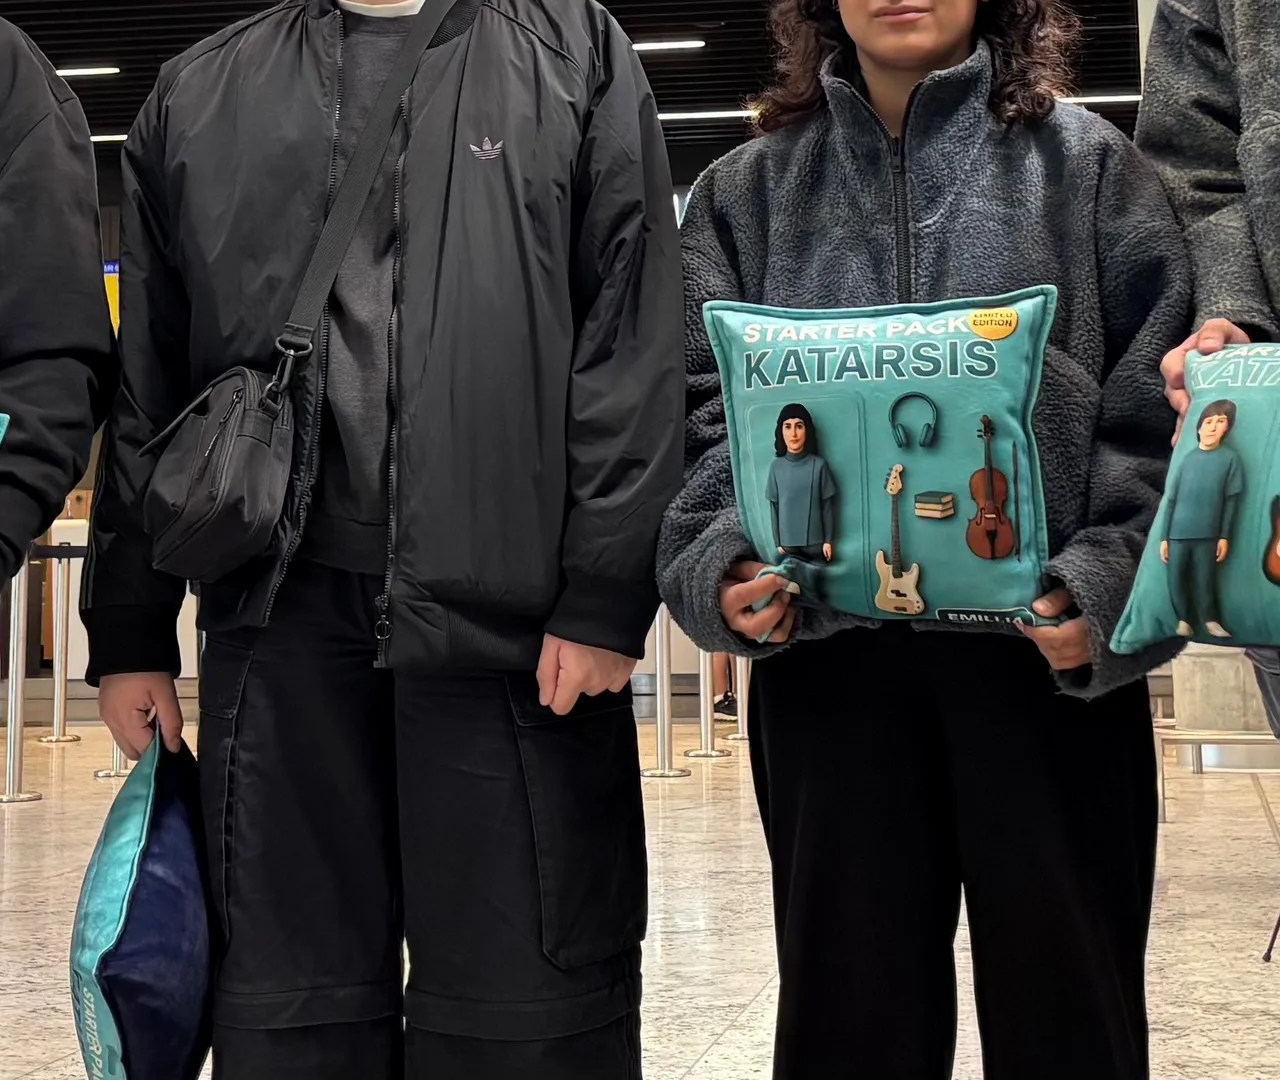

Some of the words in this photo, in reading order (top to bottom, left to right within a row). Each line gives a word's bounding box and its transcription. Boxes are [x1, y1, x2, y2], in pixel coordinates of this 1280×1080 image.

[742, 322, 882, 344] STARTER
[886, 315, 973, 338] PACK
[744, 338, 999, 391] KATARSIS
